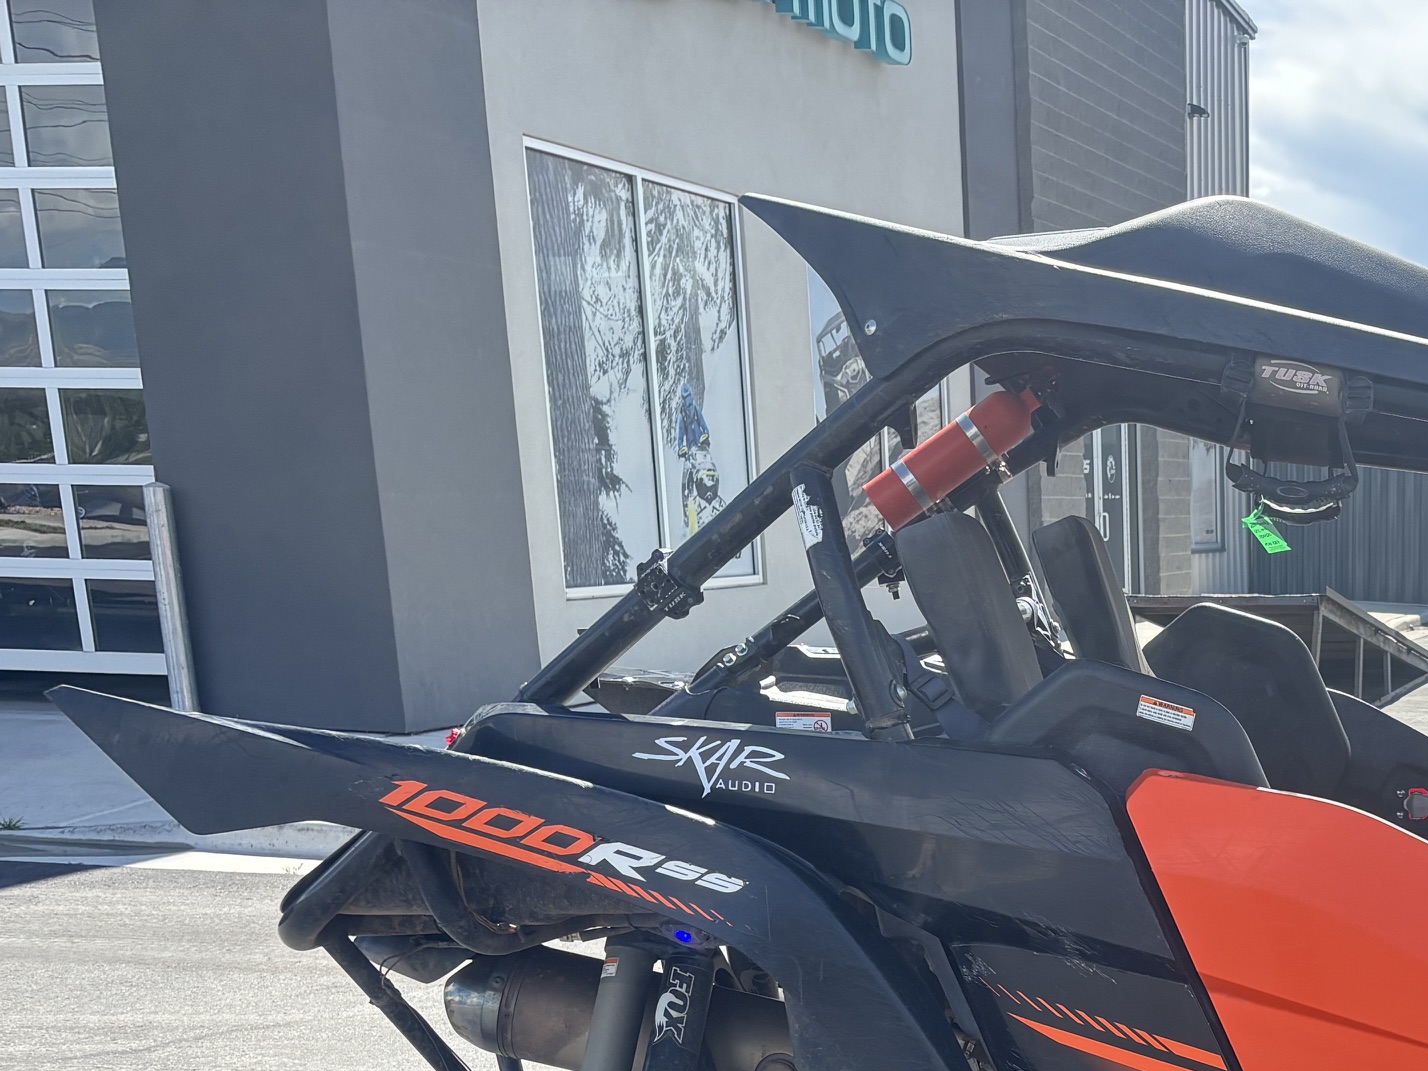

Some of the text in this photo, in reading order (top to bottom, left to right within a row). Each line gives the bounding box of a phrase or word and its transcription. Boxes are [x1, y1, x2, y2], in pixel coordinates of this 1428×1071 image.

[1261, 365, 1333, 387] TUSK
[632, 736, 791, 799] SKAR
[715, 778, 776, 794] AUDIO
[653, 966, 695, 1044] FOX
